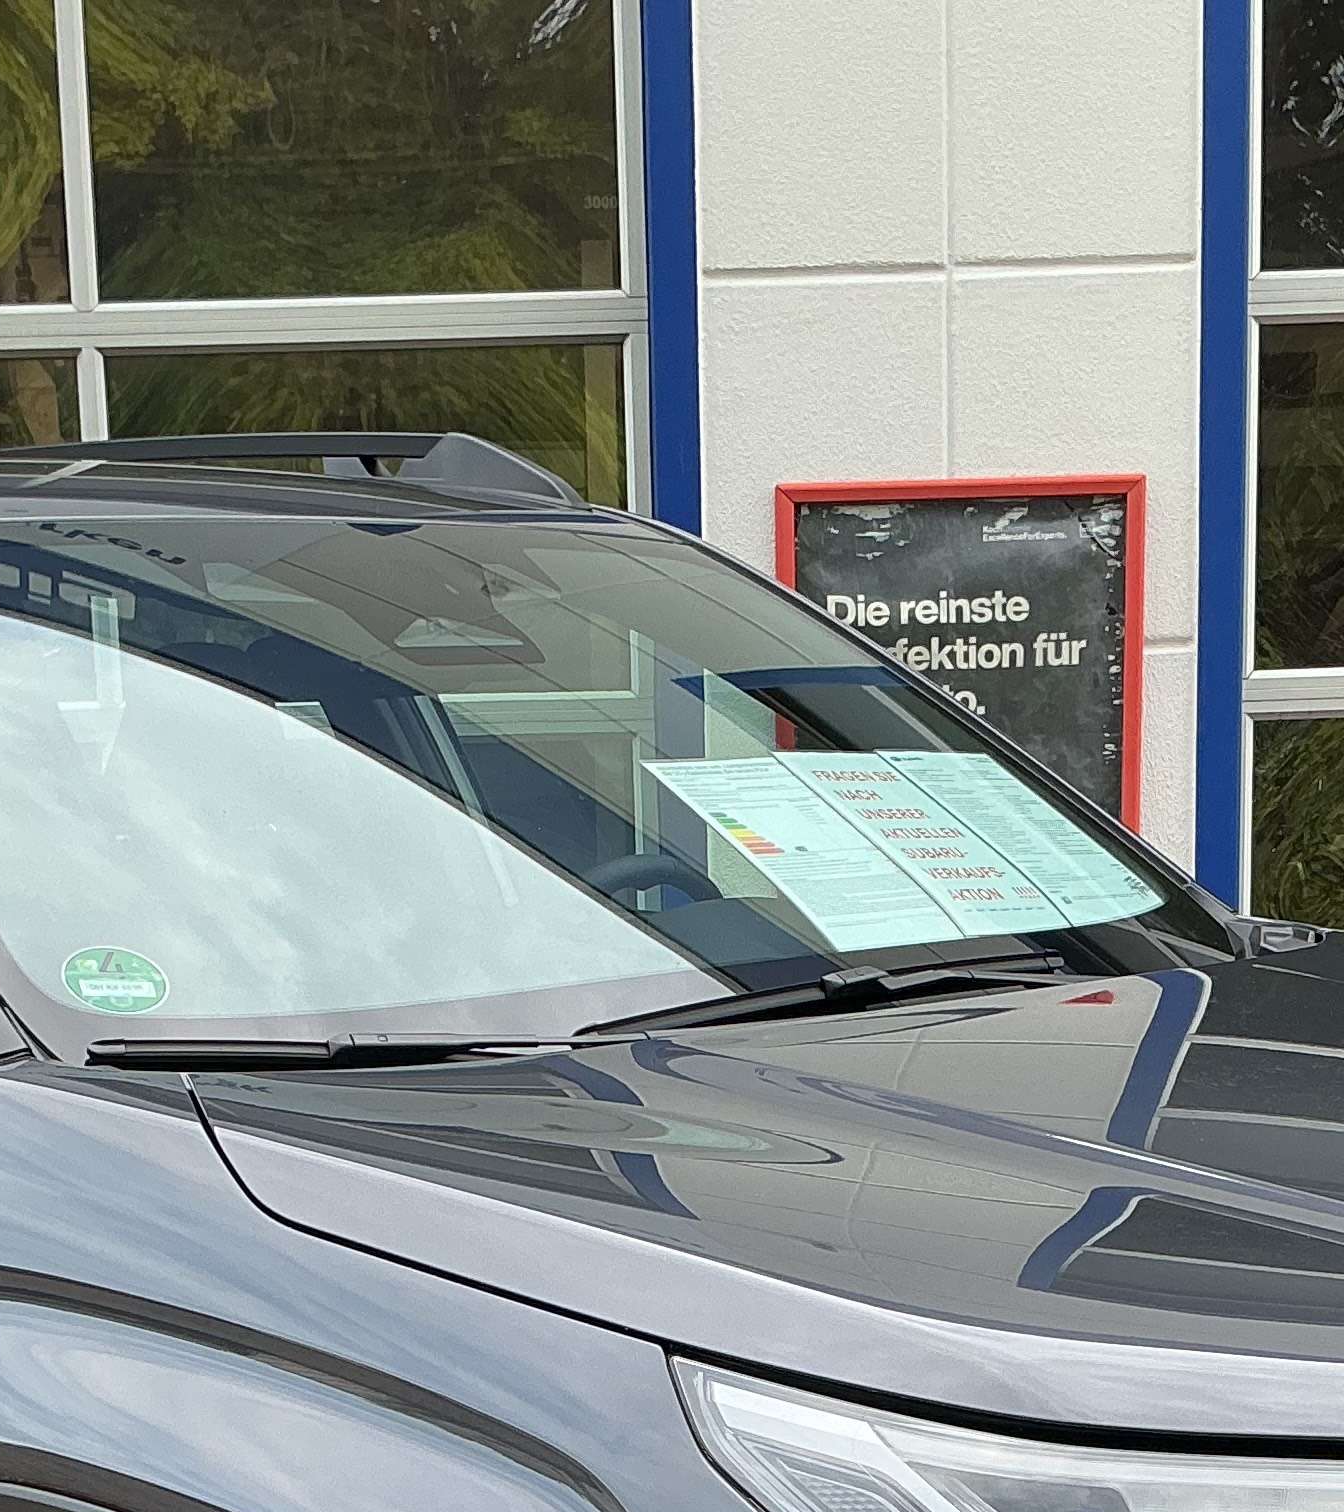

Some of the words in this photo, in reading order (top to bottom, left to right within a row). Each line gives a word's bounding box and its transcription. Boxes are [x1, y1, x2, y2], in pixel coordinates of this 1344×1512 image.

[826, 594, 890, 627] Die
[900, 590, 1030, 624] reinste
[885, 636, 1025, 671] fektion
[1032, 632, 1087, 667] für
[812, 770, 876, 783] FRAGEN
[834, 789, 883, 801] NACH
[856, 808, 929, 820] UNSERER
[879, 827, 965, 840] AKTUELLEN
[946, 886, 1004, 901] AKTION
